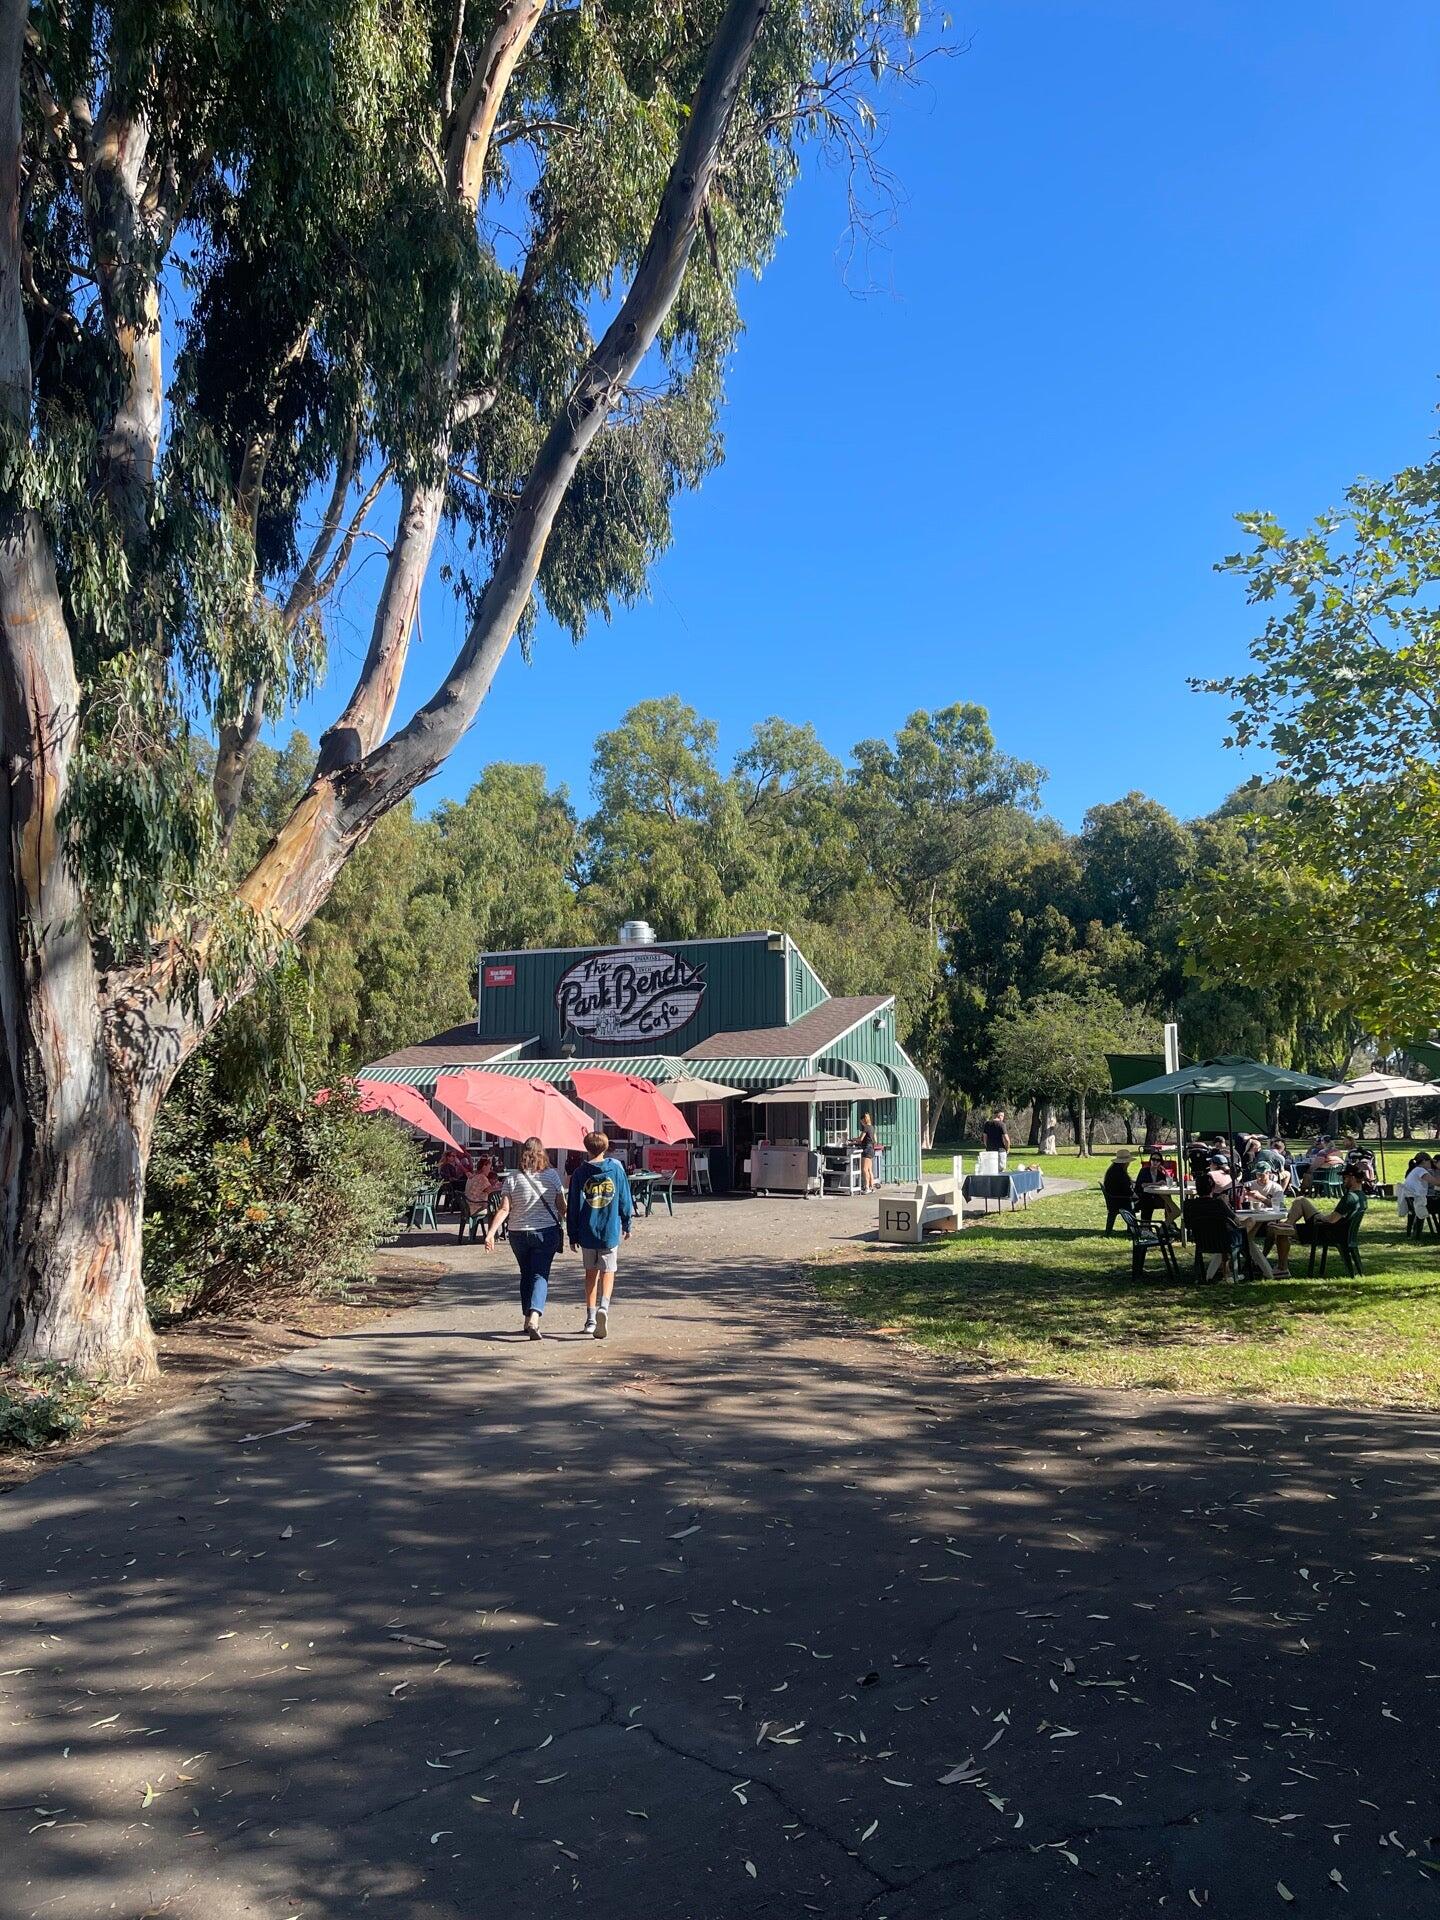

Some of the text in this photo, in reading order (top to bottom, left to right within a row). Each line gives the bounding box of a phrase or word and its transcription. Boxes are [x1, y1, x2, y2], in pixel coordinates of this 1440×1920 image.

[584, 959, 612, 981] The
[559, 953, 707, 1041] Park Bench
[585, 1182, 613, 1195] VANS
[886, 1210, 911, 1231] HB
